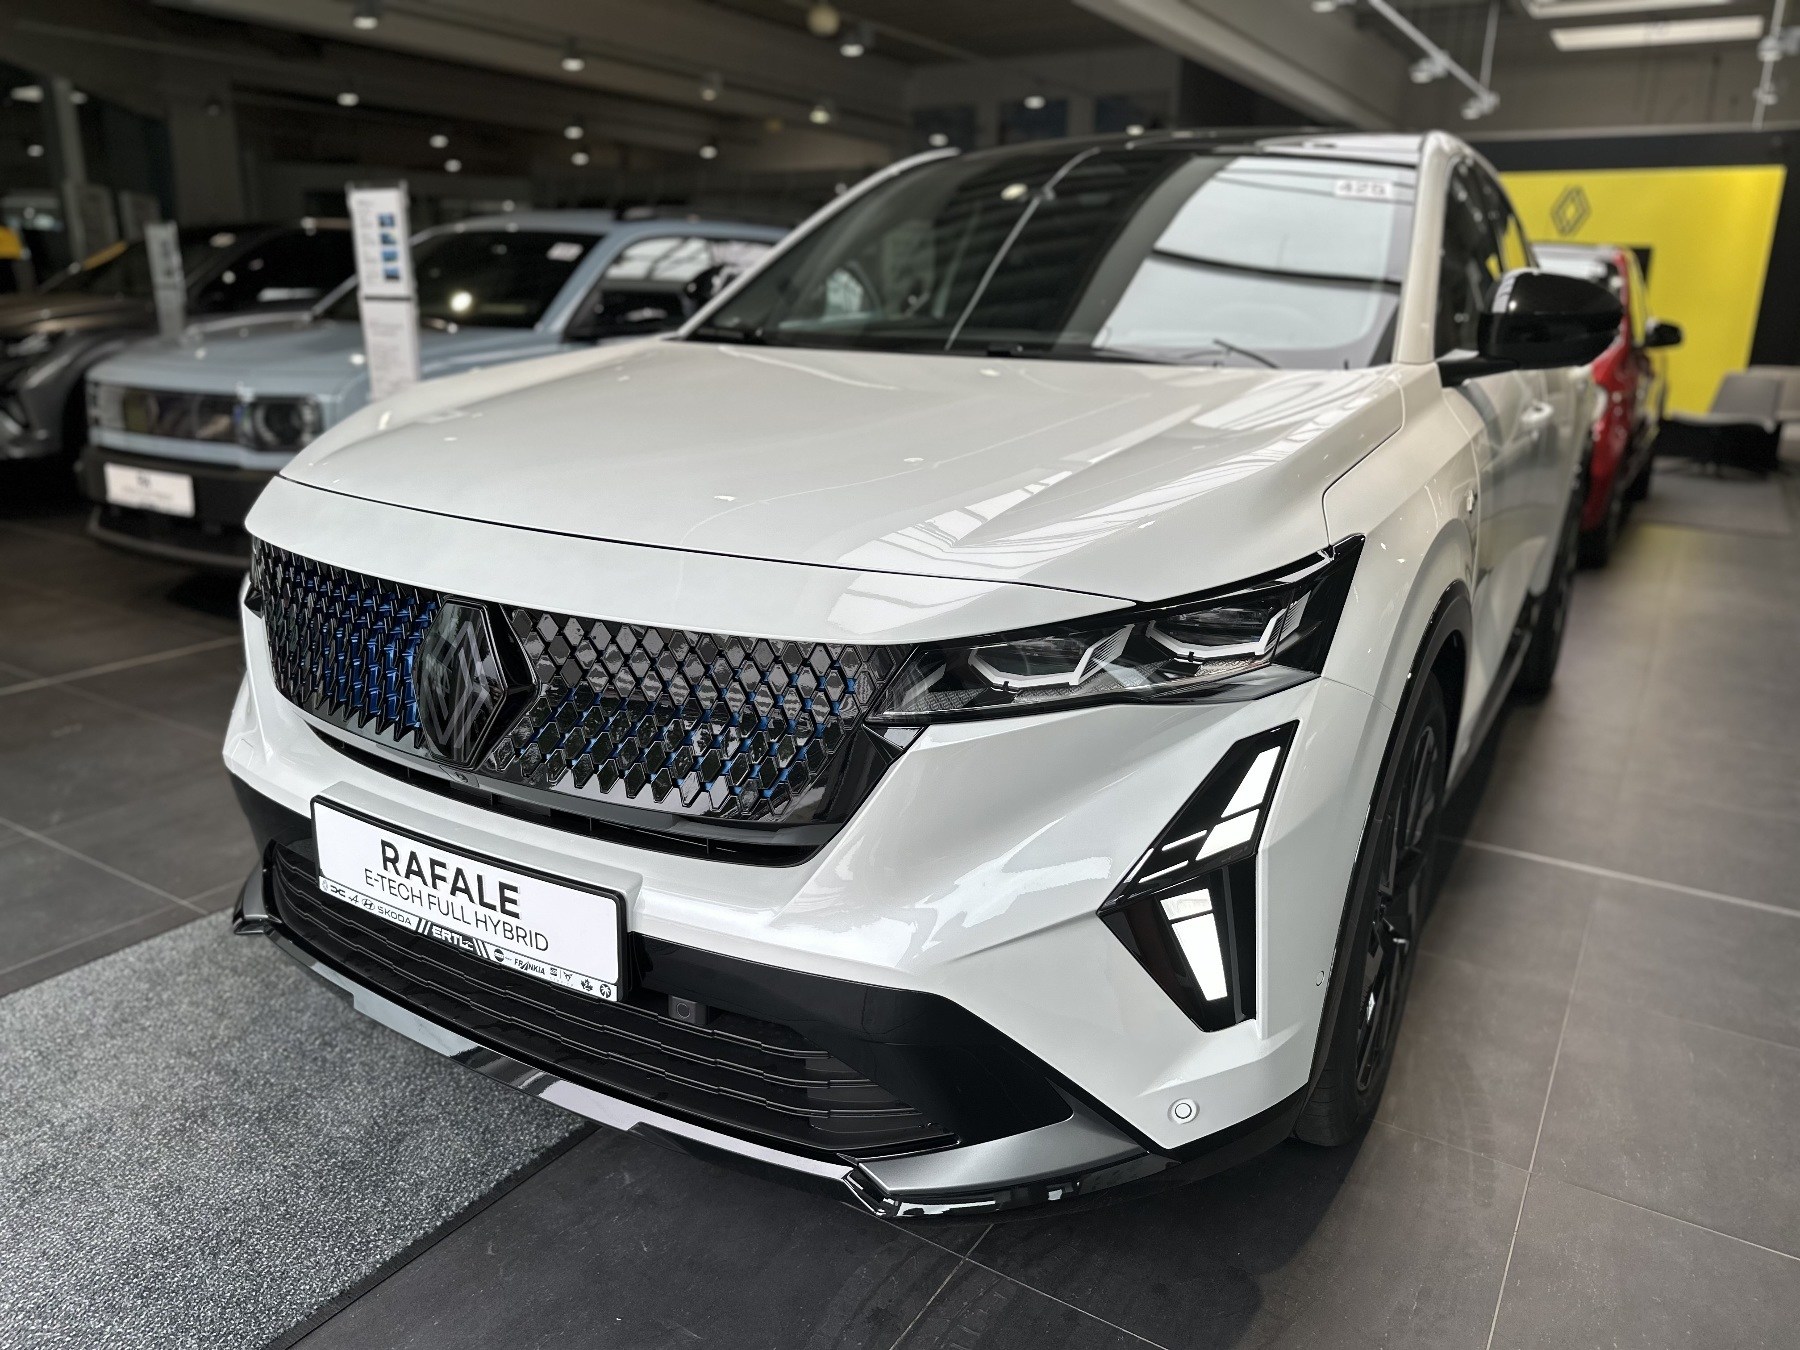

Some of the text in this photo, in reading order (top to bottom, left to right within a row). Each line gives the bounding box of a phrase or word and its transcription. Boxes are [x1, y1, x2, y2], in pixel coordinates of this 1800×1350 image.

[365, 868, 549, 951] E-TECH FULL HYBRID
[381, 839, 520, 919] RAFALE
